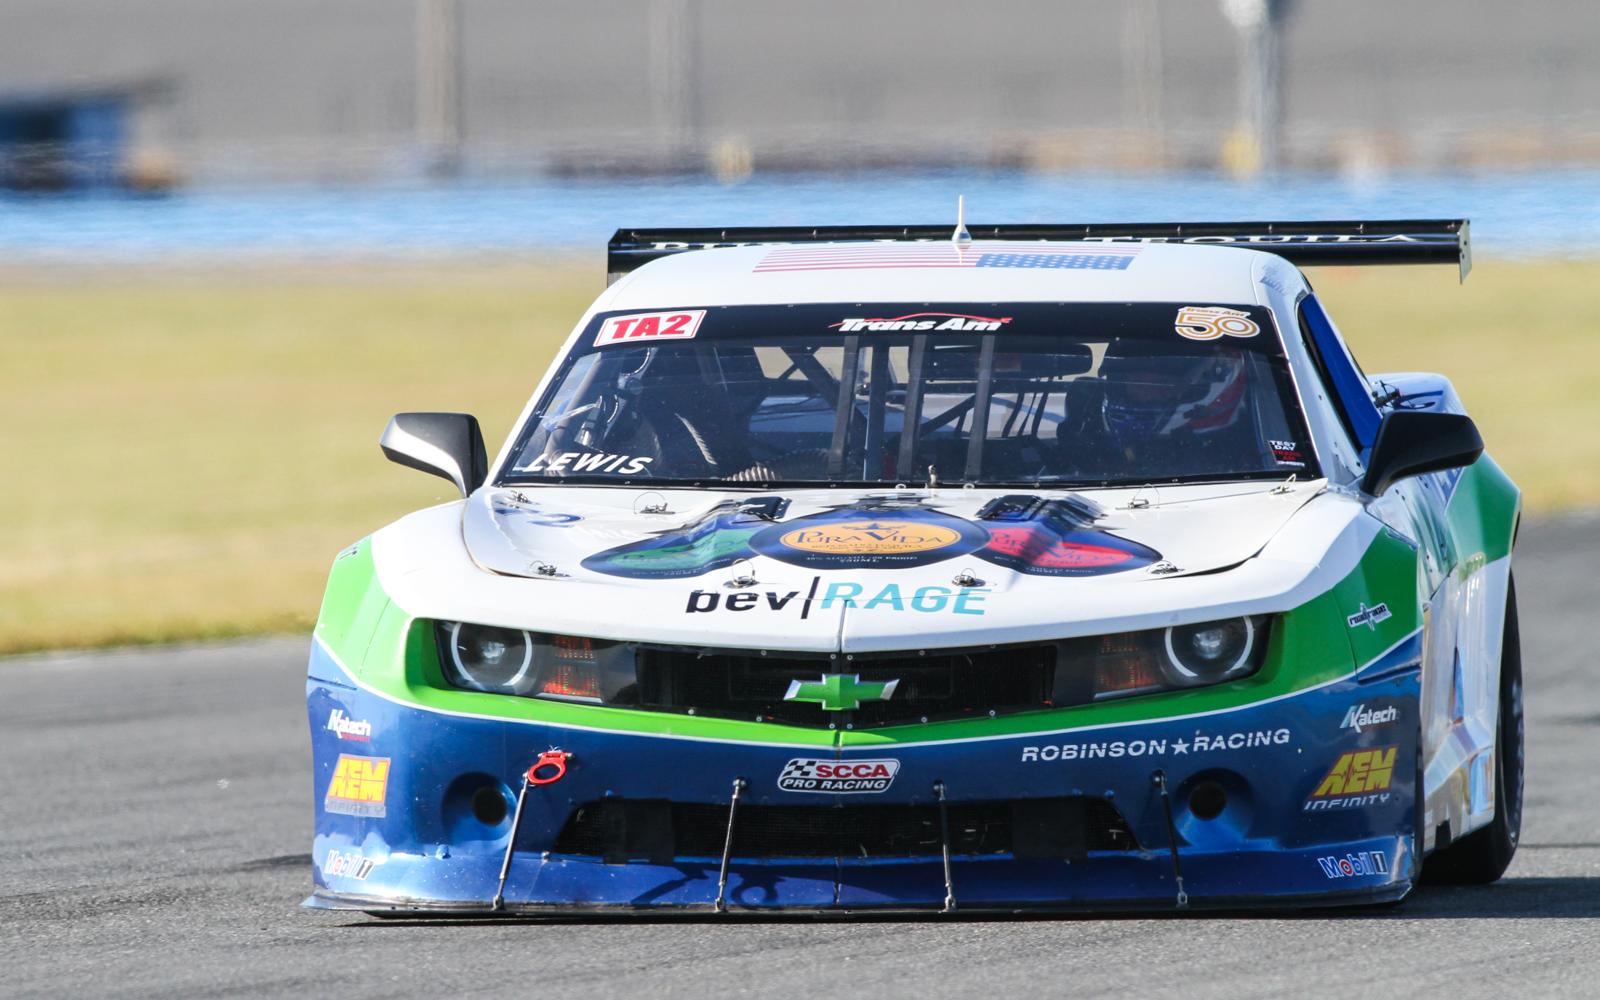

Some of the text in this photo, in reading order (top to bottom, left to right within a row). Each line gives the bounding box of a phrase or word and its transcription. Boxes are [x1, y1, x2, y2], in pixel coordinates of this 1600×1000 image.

[611, 314, 692, 339] TA2
[838, 317, 1002, 332] Trans Am
[1175, 312, 1260, 340] 50
[522, 452, 653, 474] LEWIS
[327, 709, 371, 739] Katech
[1341, 704, 1397, 733] Katech
[1021, 728, 1291, 762] ROBINSON RACING
[328, 757, 389, 801] AEM
[782, 779, 886, 790] PRO RACING
[816, 764, 890, 778] SCCA
[1313, 746, 1399, 797] AEM
[1304, 793, 1390, 810] INFINITY
[1317, 851, 1389, 878] Mobil 1
